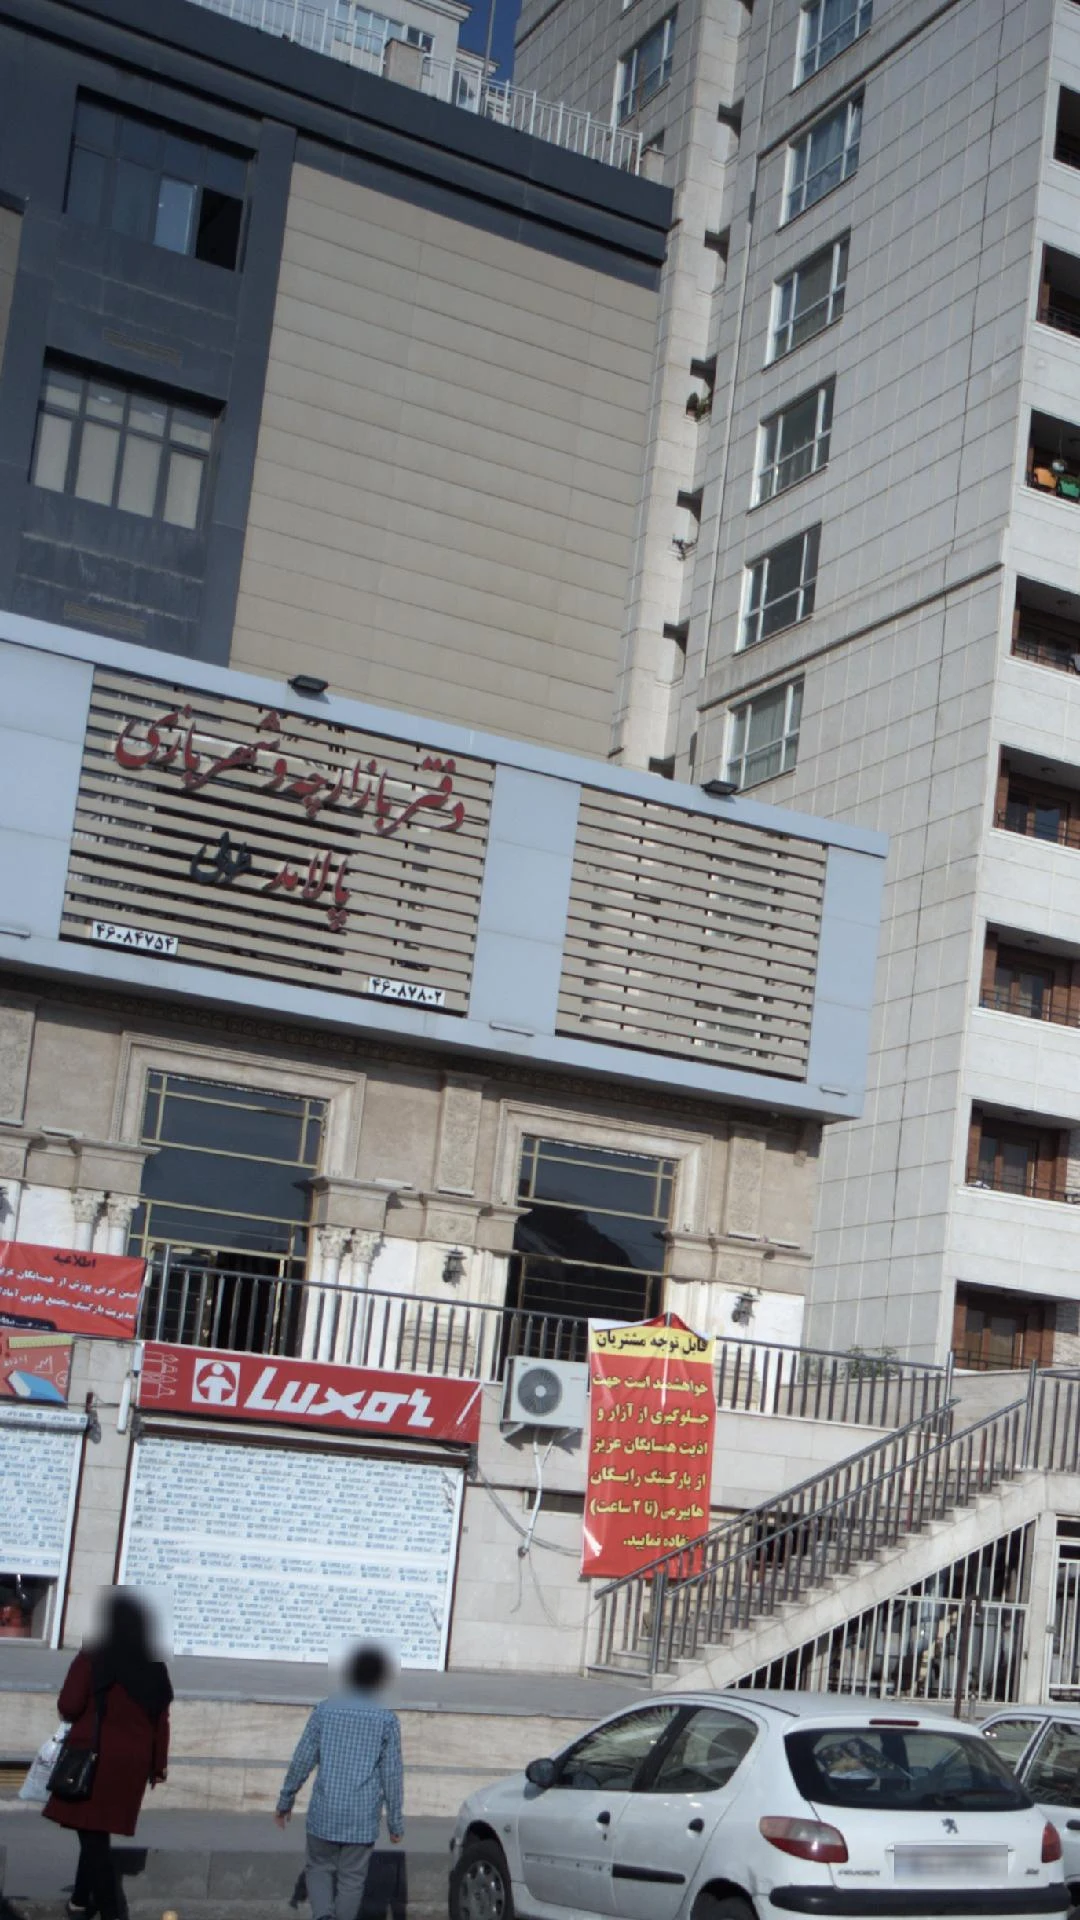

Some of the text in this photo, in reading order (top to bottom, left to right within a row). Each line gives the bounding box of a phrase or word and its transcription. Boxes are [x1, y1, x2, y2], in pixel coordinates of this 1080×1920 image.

[375, 755, 466, 838] دفتر
[596, 1329, 709, 1355] قابل توجه مشتریان
[592, 1374, 622, 1389] جهت
[624, 1375, 651, 1389] است
[596, 1402, 709, 1428] جلوگیری از آزار و
[592, 1437, 622, 1454] عزیز
[678, 1440, 709, 1458] اذیت
[590, 1466, 707, 1491] از پارکینگ رایگان
